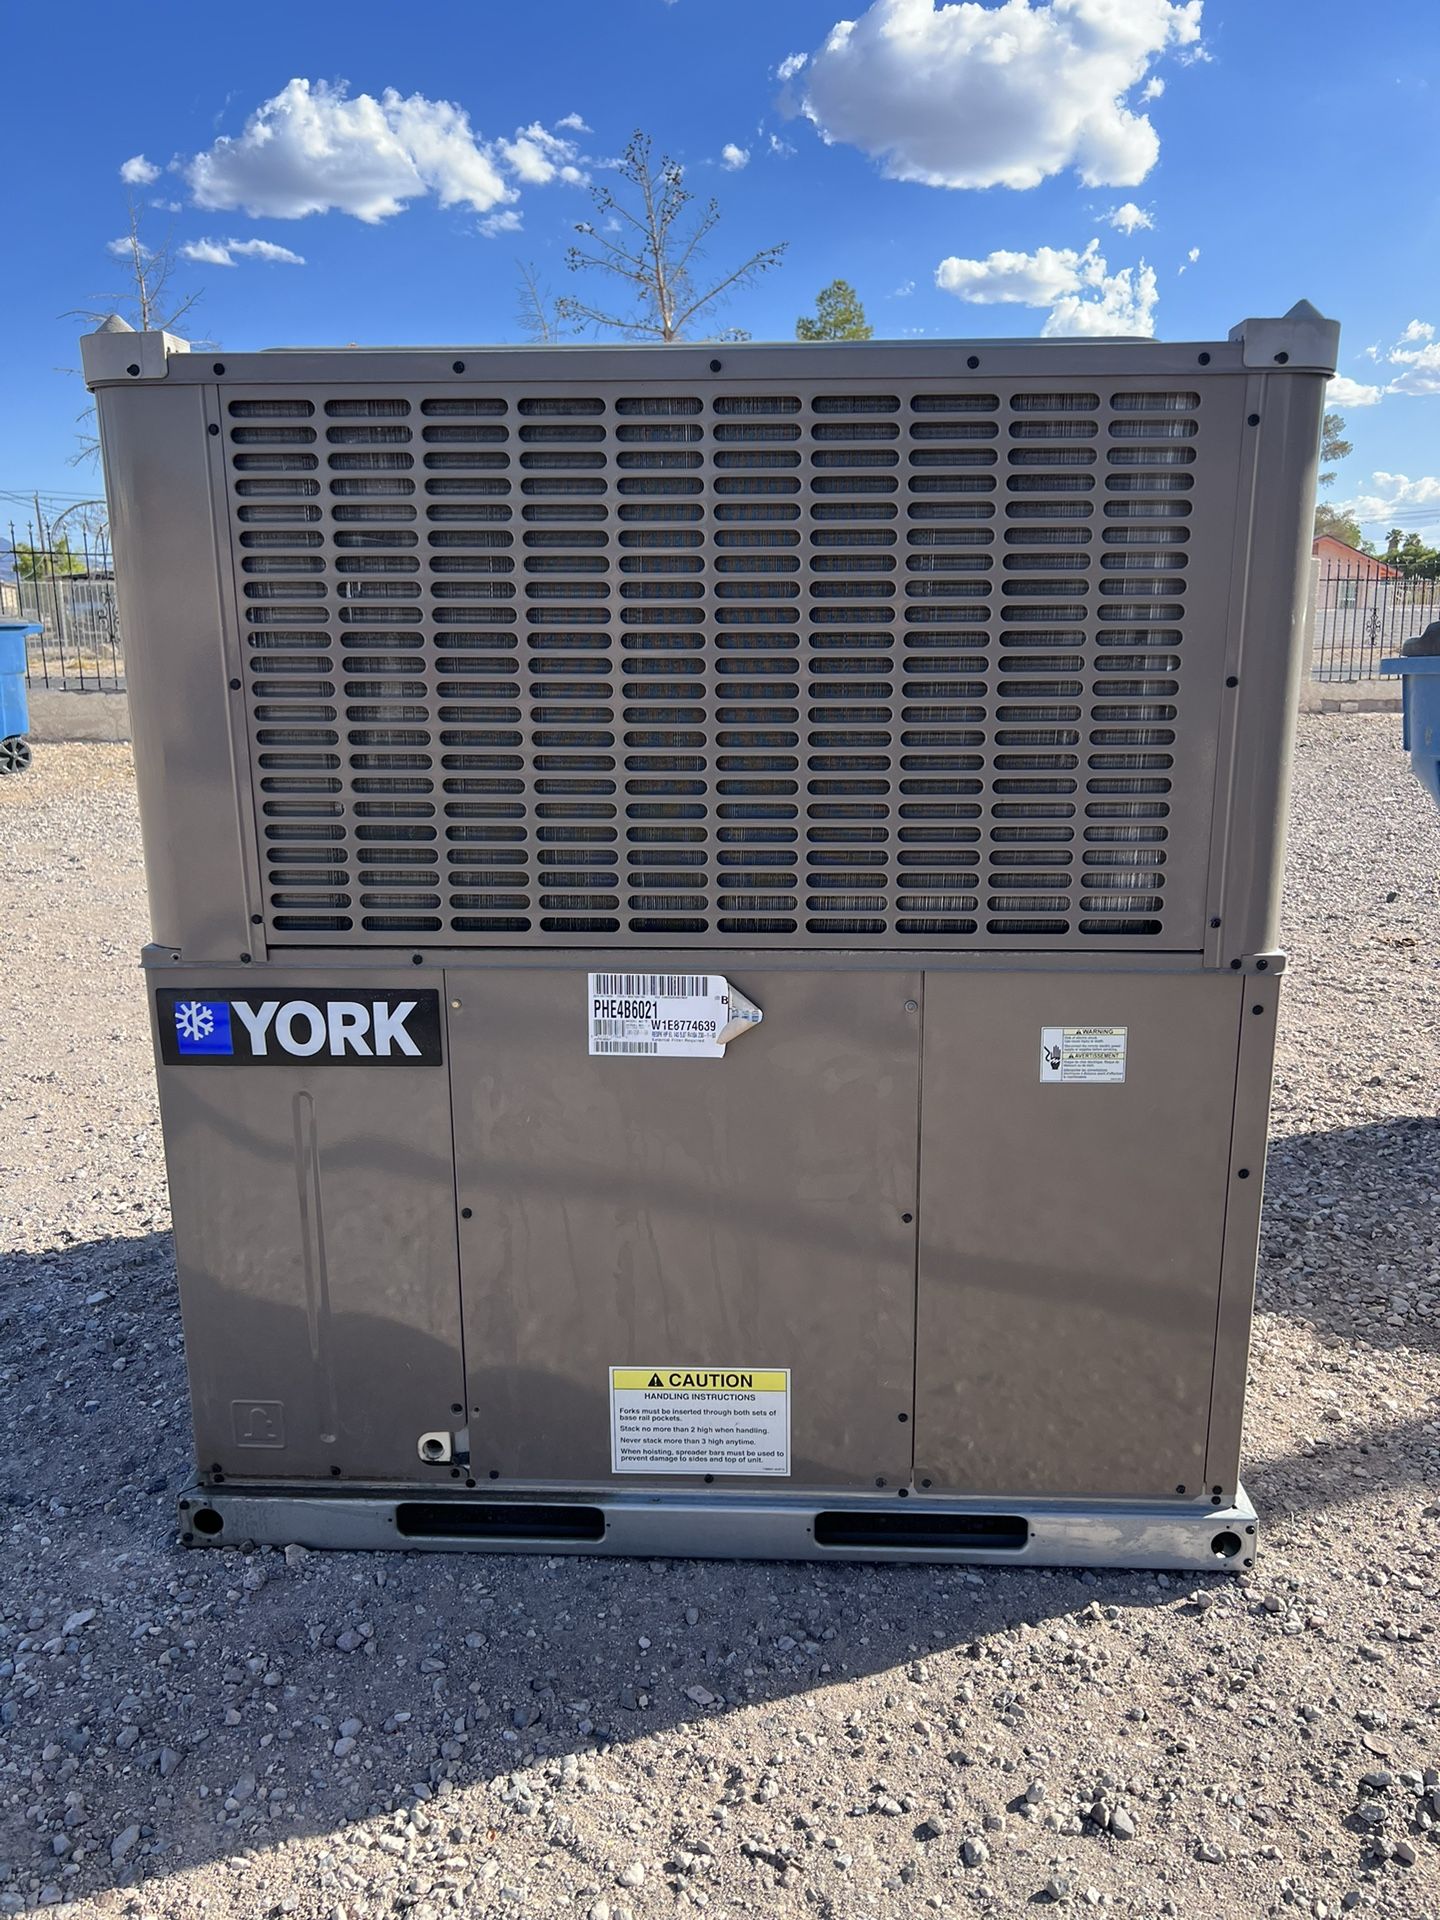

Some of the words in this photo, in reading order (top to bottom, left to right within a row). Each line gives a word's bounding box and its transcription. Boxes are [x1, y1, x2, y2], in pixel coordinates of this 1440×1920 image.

[594, 1000, 658, 1019] PHE4B6021
[230, 1000, 422, 1056] YORK
[651, 1020, 716, 1031] W1E8774639
[669, 1374, 752, 1387] CAUTION
